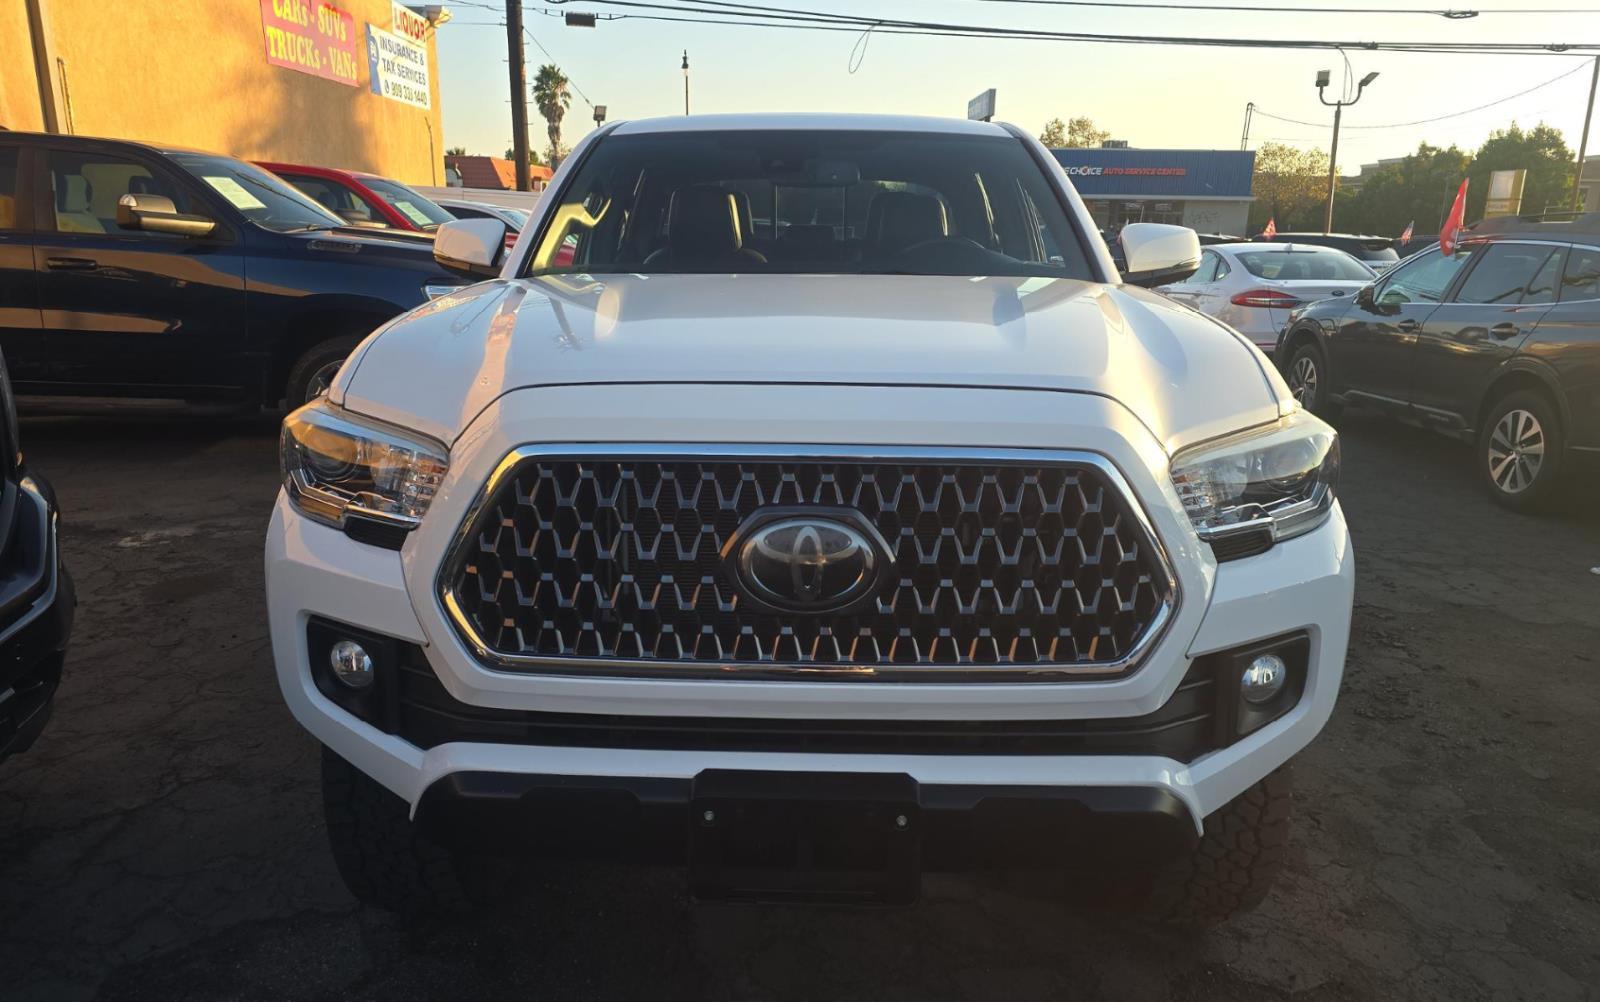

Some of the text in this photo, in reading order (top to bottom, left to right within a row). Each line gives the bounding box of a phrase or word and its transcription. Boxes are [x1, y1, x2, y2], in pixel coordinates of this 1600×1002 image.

[393, 8, 426, 42] LIQUOR
[380, 36, 418, 64] INSURANCE
[419, 53, 425, 66] &
[382, 57, 426, 86] TAX SERVICES
[1103, 166, 1123, 176] AUTO
[1124, 166, 1156, 176] SERVICE
[1157, 166, 1186, 176] CENTER
